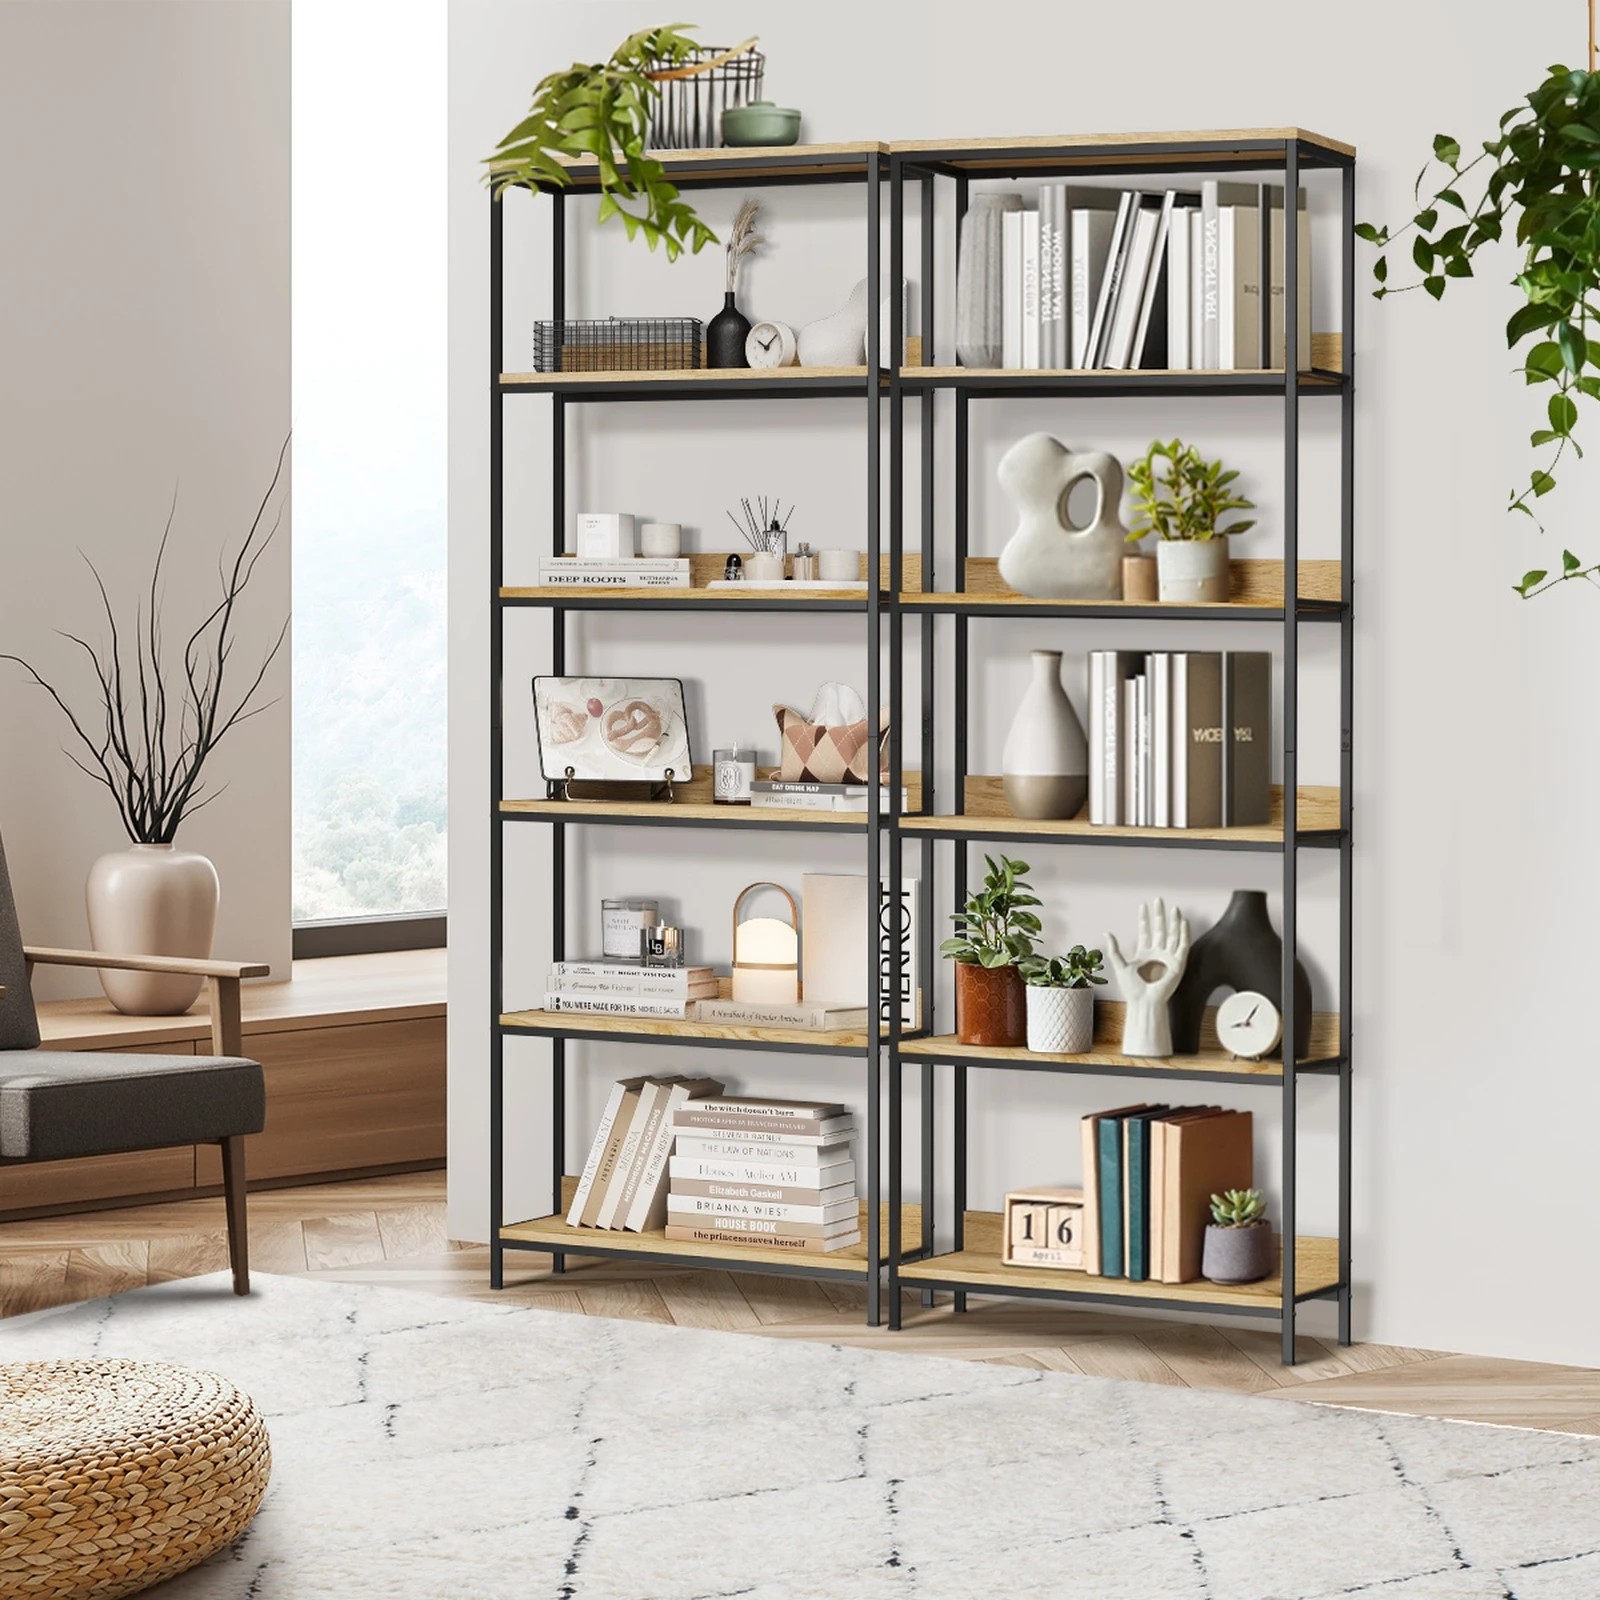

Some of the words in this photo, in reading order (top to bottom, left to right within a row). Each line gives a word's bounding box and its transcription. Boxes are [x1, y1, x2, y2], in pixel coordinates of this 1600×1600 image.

[548, 575, 580, 583] DEEP
[583, 576, 627, 584] ROOTS
[771, 783, 784, 791] EAT
[562, 1000, 574, 1009] YOU
[574, 1001, 592, 1010] WERE
[592, 1002, 609, 1011] MADE
[609, 1003, 622, 1012] FOR
[702, 1143, 719, 1153] THE
[722, 1145, 740, 1155] LAW
[742, 1147, 754, 1156] OF
[756, 1148, 796, 1159] NATIONS
[709, 1185, 749, 1197] Elizabeth
[750, 1188, 783, 1200] Gaskell
[696, 1200, 750, 1214] BRIANNA
[754, 1205, 789, 1217] WIEST
[715, 1217, 748, 1231] HOUSE
[749, 1220, 777, 1232] BOOK
[1022, 1213, 1034, 1240] 1
[1057, 1217, 1073, 1245] 6
[693, 1230, 710, 1241] the
[709, 1232, 750, 1245] princess
[774, 1237, 807, 1248] herself
